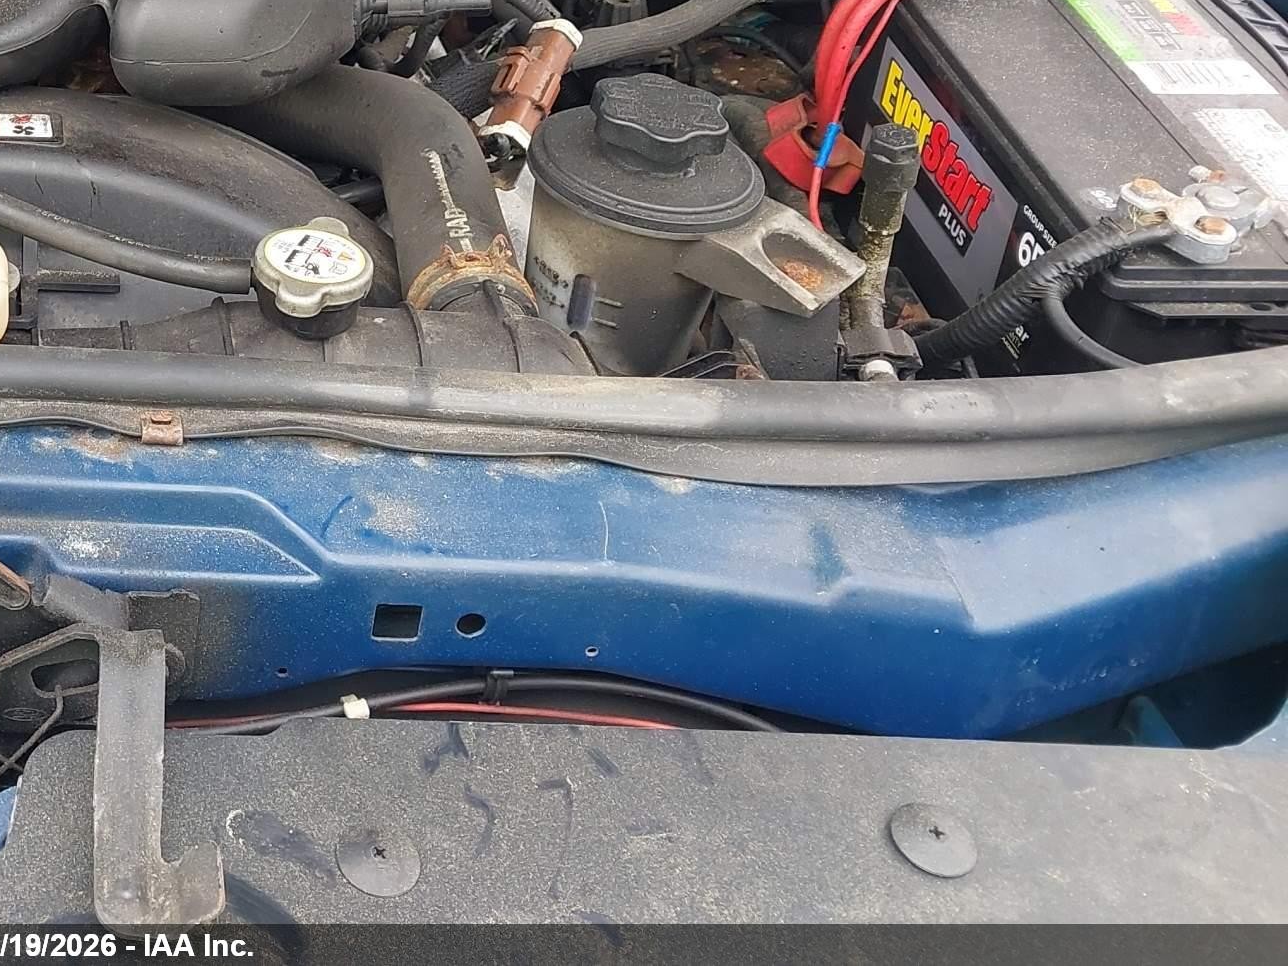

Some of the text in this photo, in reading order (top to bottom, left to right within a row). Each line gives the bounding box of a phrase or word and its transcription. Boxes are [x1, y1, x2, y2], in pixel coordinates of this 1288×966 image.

[880, 58, 993, 234] EverStart
[938, 203, 967, 247] PLUS
[1023, 204, 1058, 249] GROUP SIZE
